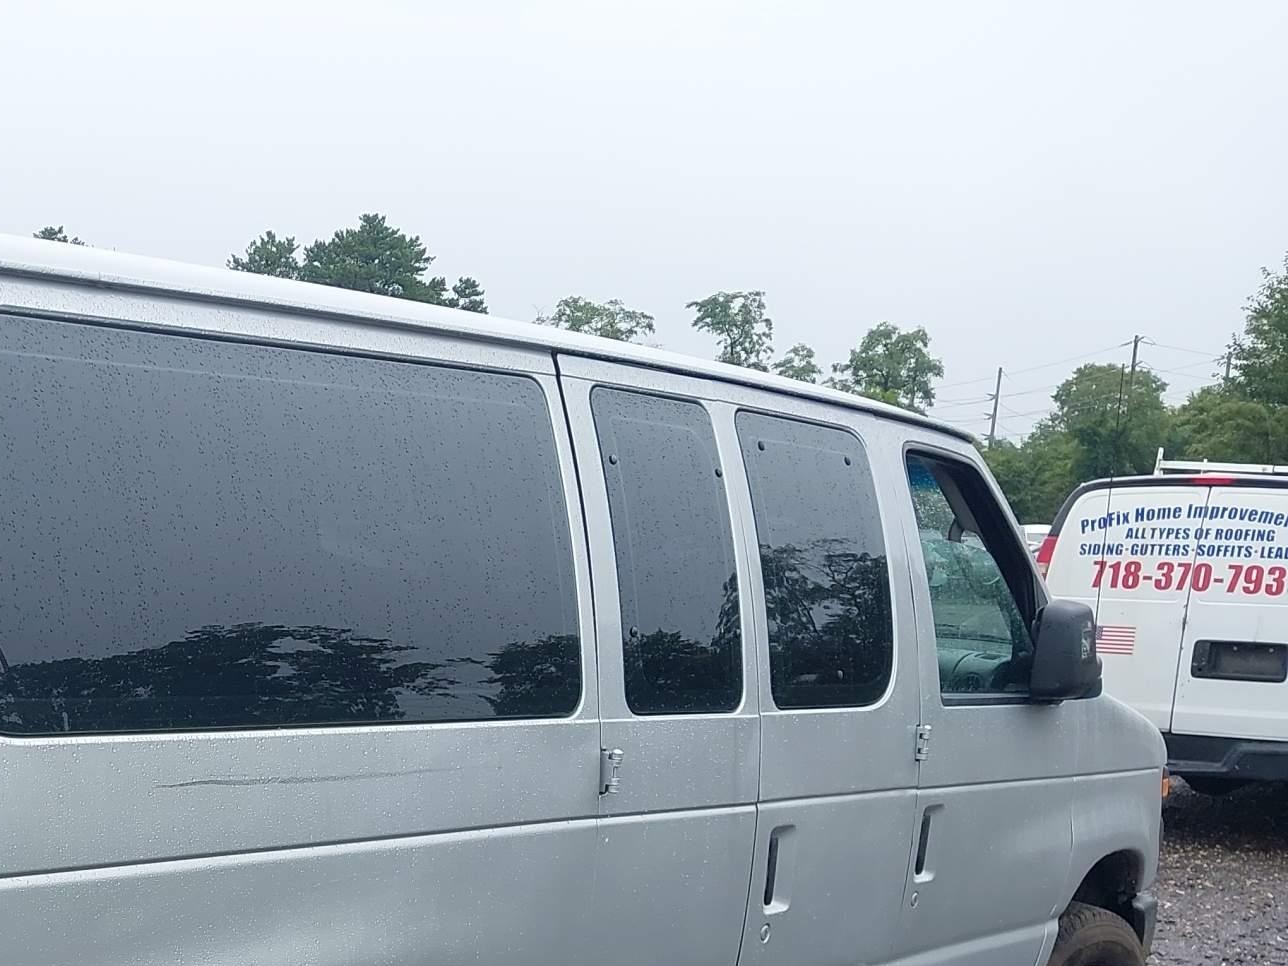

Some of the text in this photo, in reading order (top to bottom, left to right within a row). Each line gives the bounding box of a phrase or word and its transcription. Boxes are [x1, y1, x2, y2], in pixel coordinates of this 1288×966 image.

[1081, 510, 1131, 535] ProFix
[1135, 505, 1183, 524] Home
[1125, 527, 1277, 543] ALL TYPES OF ROOFING
[1079, 543, 1124, 555] SIDING
[1131, 544, 1191, 557] GUTTERS
[1197, 544, 1254, 558] SOFFITS
[1091, 560, 1288, 596] 718-370-793
